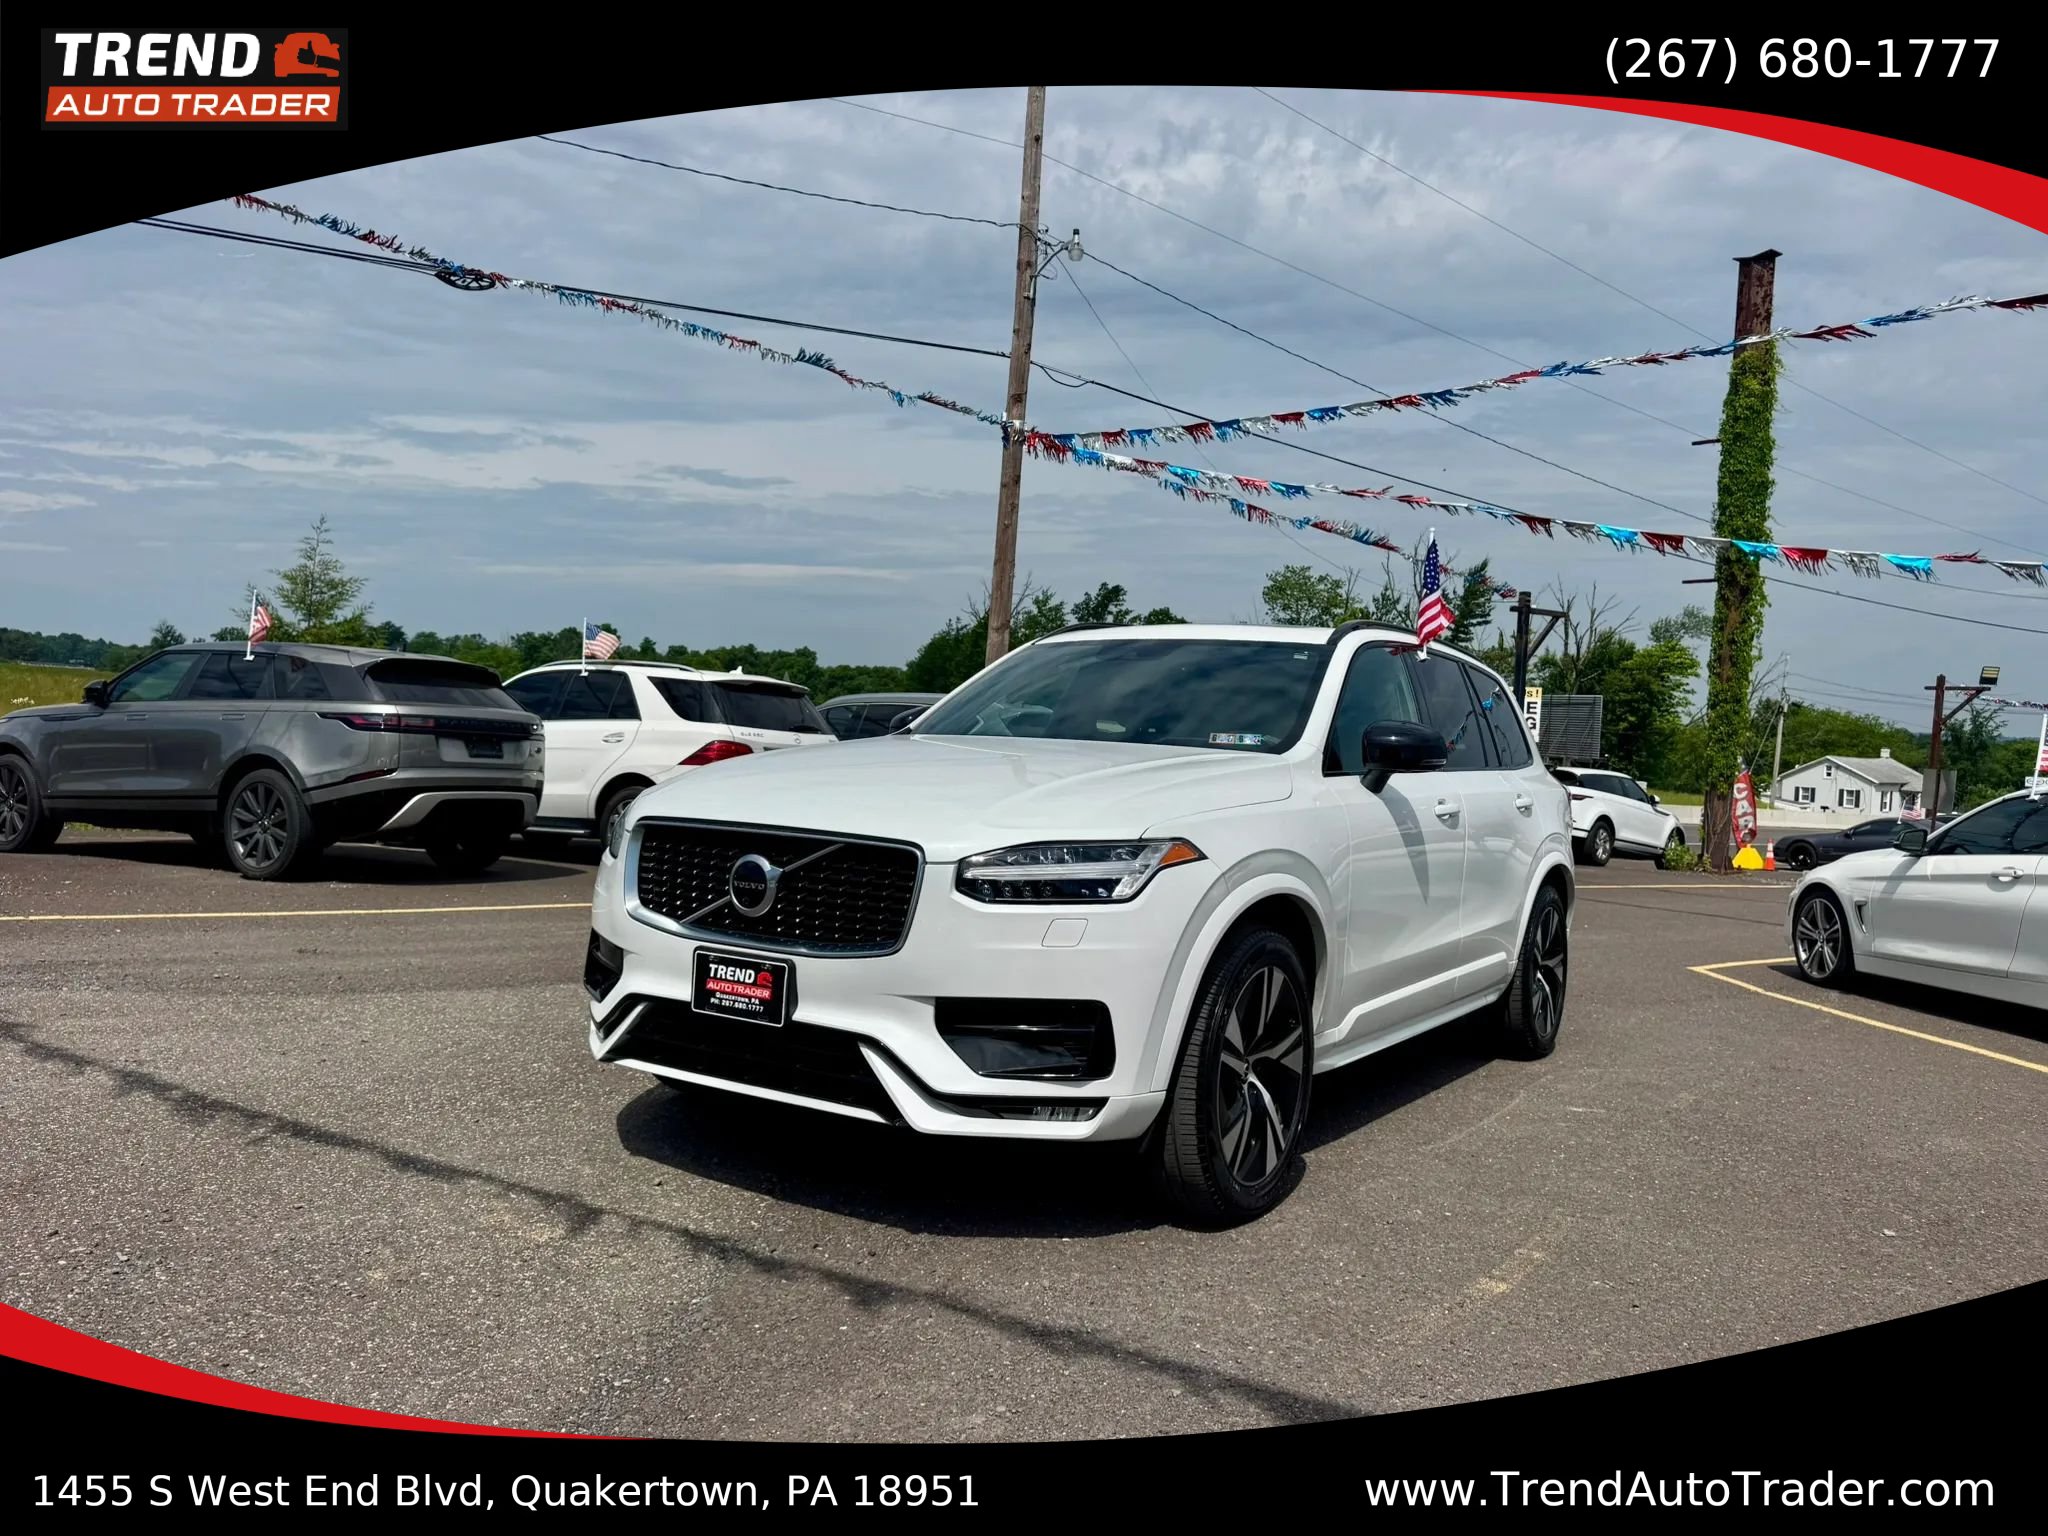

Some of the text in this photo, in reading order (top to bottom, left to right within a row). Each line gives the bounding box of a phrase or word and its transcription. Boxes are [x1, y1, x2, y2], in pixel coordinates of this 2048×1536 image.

[733, 880, 765, 890] VOLVO
[709, 963, 755, 984] TREND
[706, 981, 770, 998] AUTO TRADER
